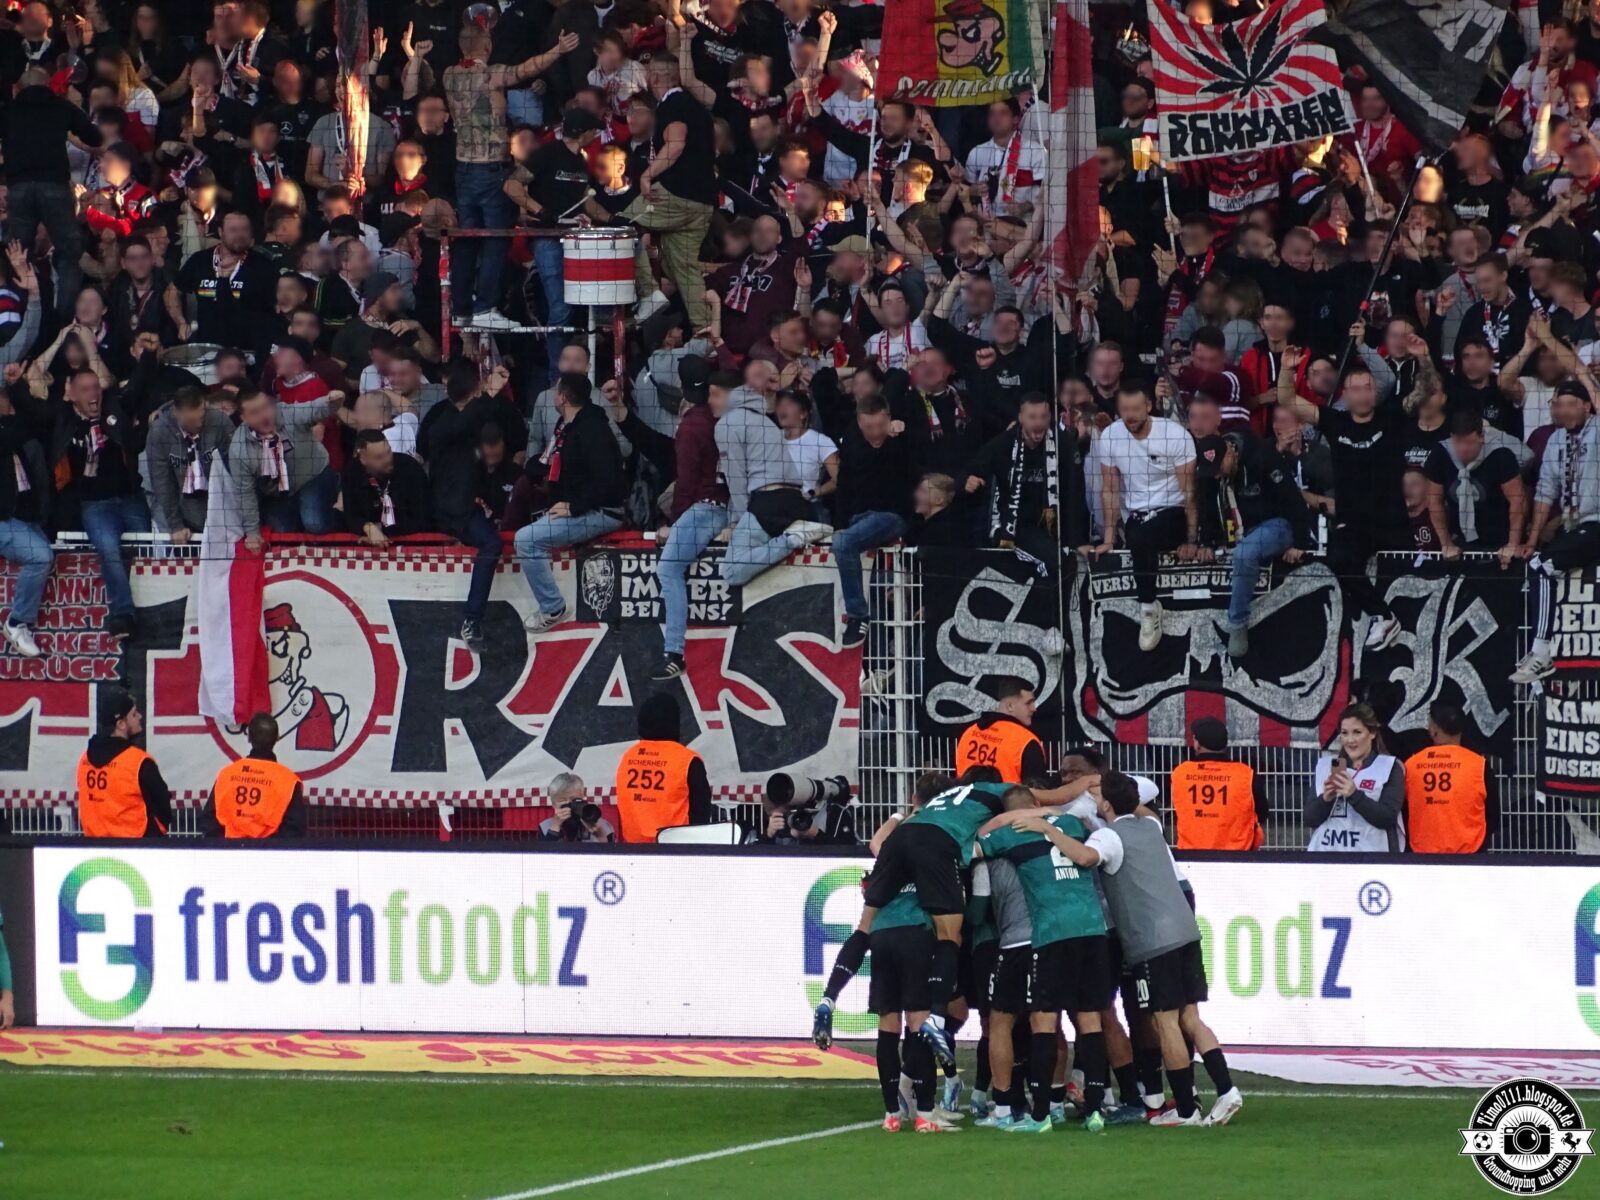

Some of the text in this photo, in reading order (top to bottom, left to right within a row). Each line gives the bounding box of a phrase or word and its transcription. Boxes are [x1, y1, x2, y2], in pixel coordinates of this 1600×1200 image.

[1168, 88, 1344, 133] SCHWABEN
[1169, 112, 1350, 158] KOMPANIE
[689, 556, 725, 577] IST
[620, 575, 732, 602] IMER
[0, 605, 109, 629] HRT
[619, 601, 734, 621] BEI NS!
[1545, 726, 1600, 755] EINS
[967, 740, 997, 766] 264
[86, 769, 107, 790] 66
[627, 769, 665, 791] 252
[1186, 774, 1231, 782] SICHERHEIT
[1423, 771, 1452, 792] 98
[235, 785, 262, 806] 89
[1188, 784, 1228, 806] 191
[1321, 828, 1361, 847] SMF
[1054, 867, 1080, 881] ANTON
[179, 886, 588, 986] freshfoodz
